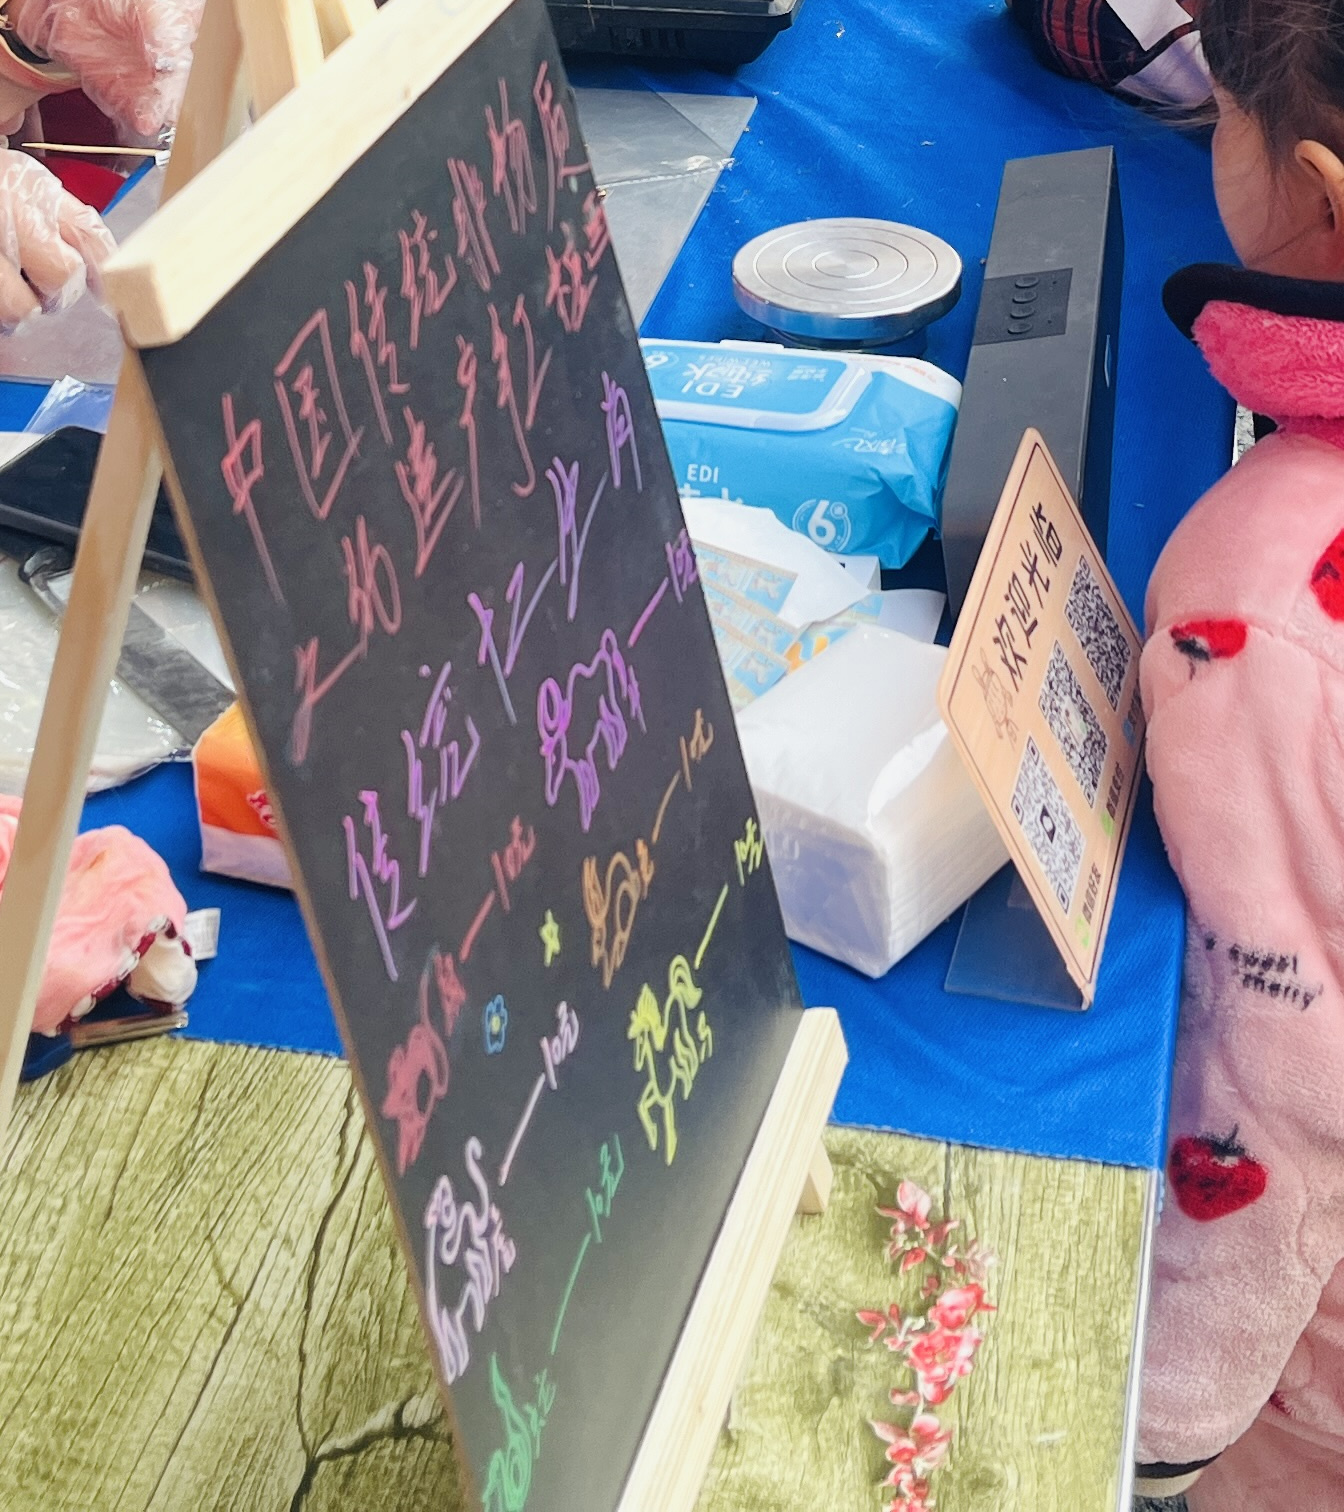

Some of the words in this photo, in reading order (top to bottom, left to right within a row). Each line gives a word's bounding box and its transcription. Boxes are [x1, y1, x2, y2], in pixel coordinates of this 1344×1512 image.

[681, 381, 745, 399] EDI
[686, 464, 720, 484] EDI
[807, 499, 838, 547] 6
[992, 501, 1064, 693] 欢迎光临
[541, 999, 580, 1091] 10元
